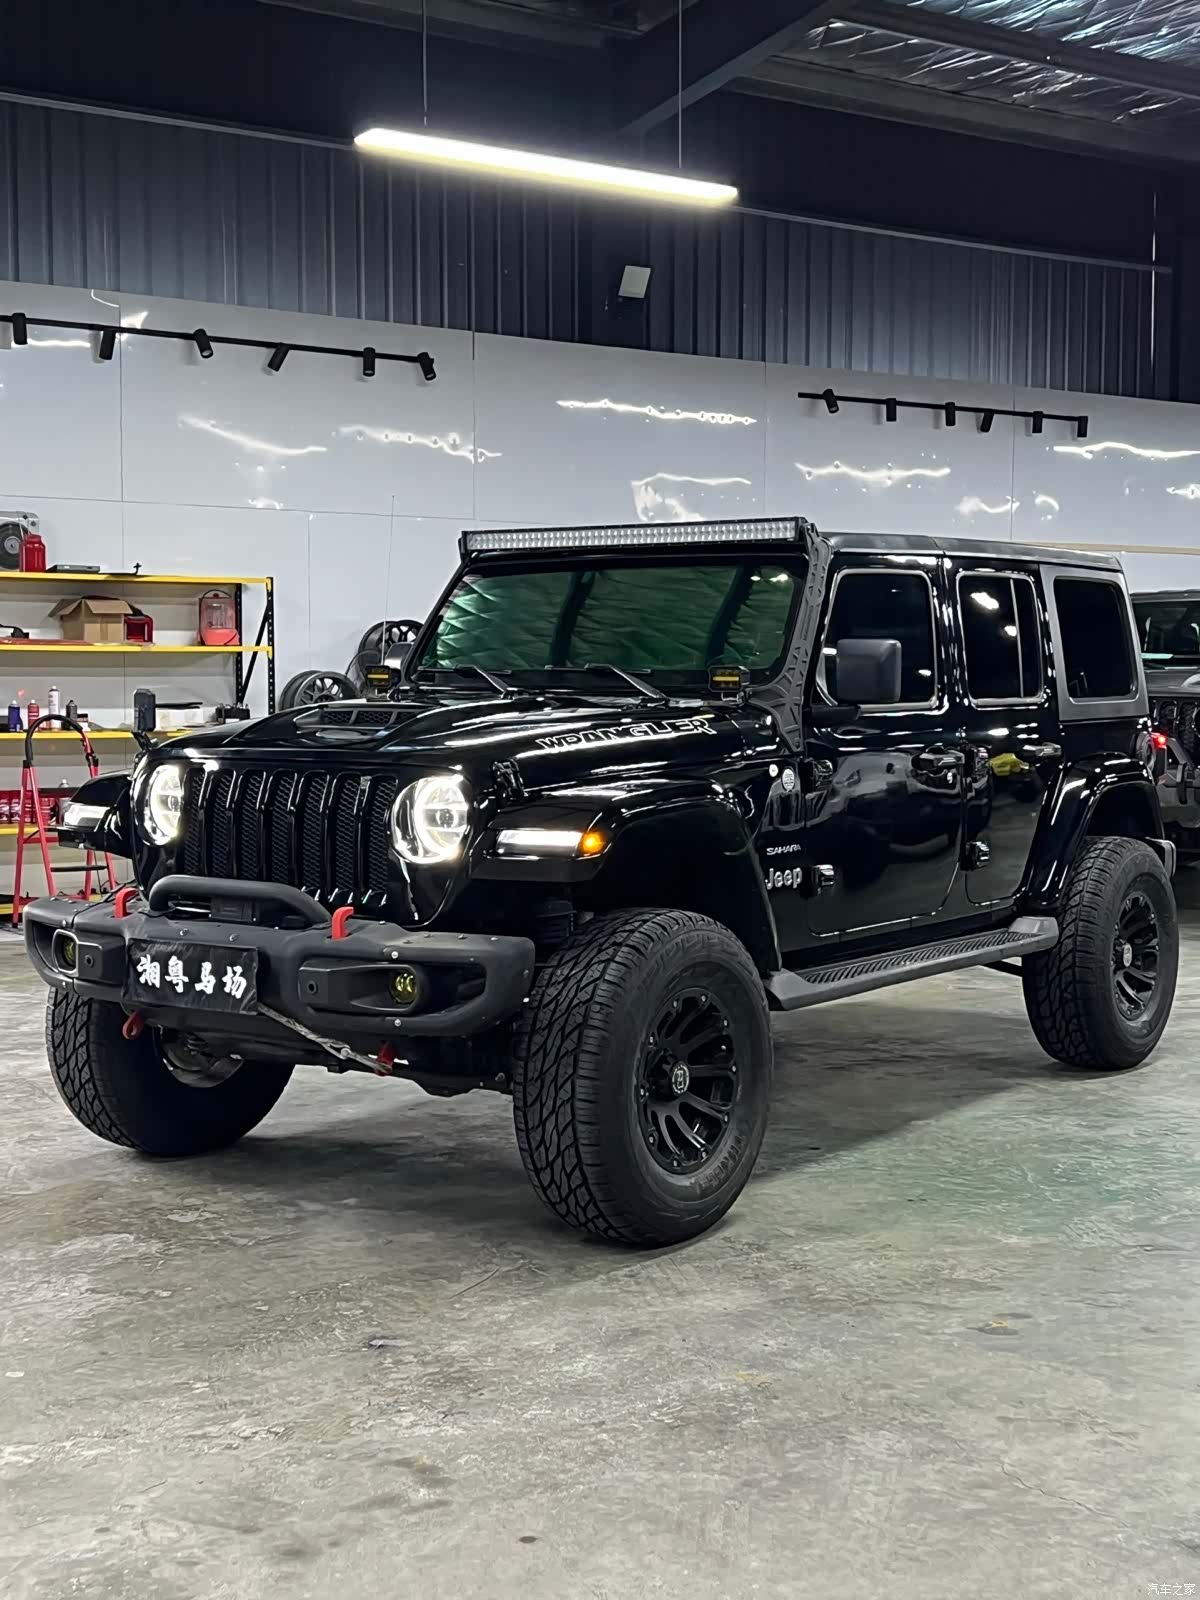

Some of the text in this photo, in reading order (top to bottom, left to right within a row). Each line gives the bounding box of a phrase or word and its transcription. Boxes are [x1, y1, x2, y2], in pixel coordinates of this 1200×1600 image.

[535, 717, 718, 750] WRANGLER
[766, 844, 801, 855] SAHARA
[765, 867, 802, 890] Jeep
[136, 954, 247, 999] 湘粤马场
